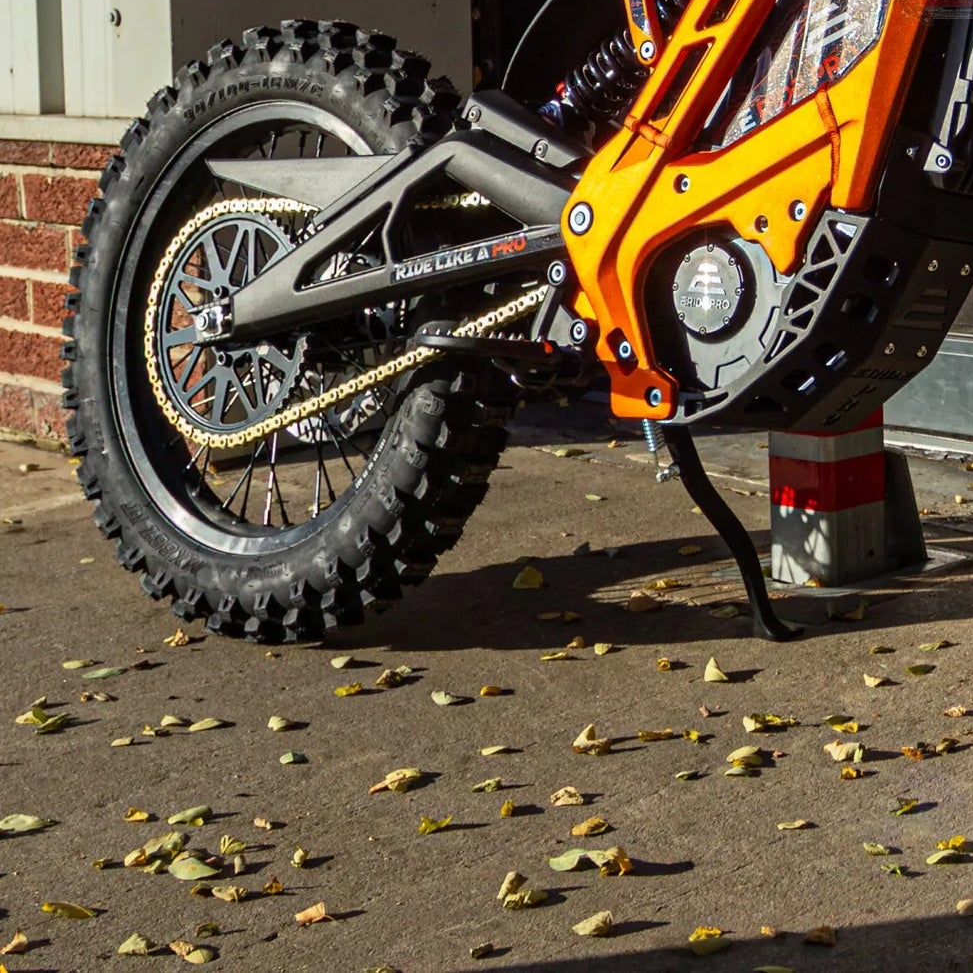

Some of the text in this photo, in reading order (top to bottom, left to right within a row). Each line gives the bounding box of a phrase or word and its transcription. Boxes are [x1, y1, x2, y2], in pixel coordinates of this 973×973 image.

[394, 234, 528, 281] RIDE LIKE A PRO
